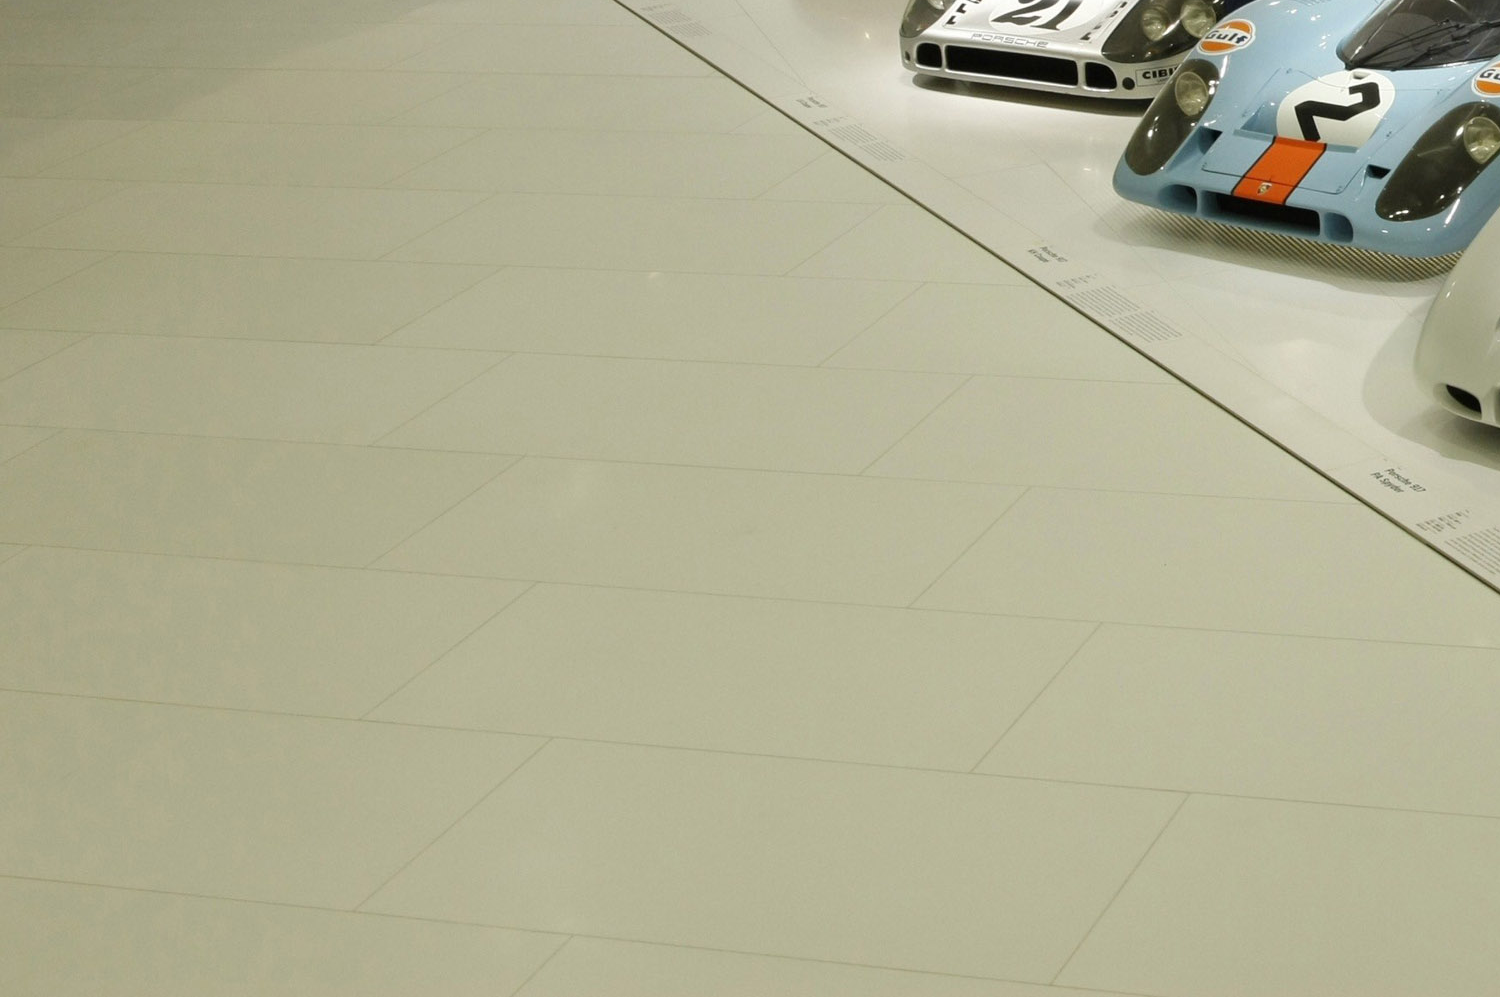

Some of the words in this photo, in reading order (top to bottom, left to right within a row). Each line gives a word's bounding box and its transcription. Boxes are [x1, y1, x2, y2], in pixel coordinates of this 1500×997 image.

[970, 31, 1050, 49] PORSCHE
[1203, 30, 1248, 46] Gulf
[1142, 66, 1178, 80] CIBI
[1294, 81, 1380, 142] 2
